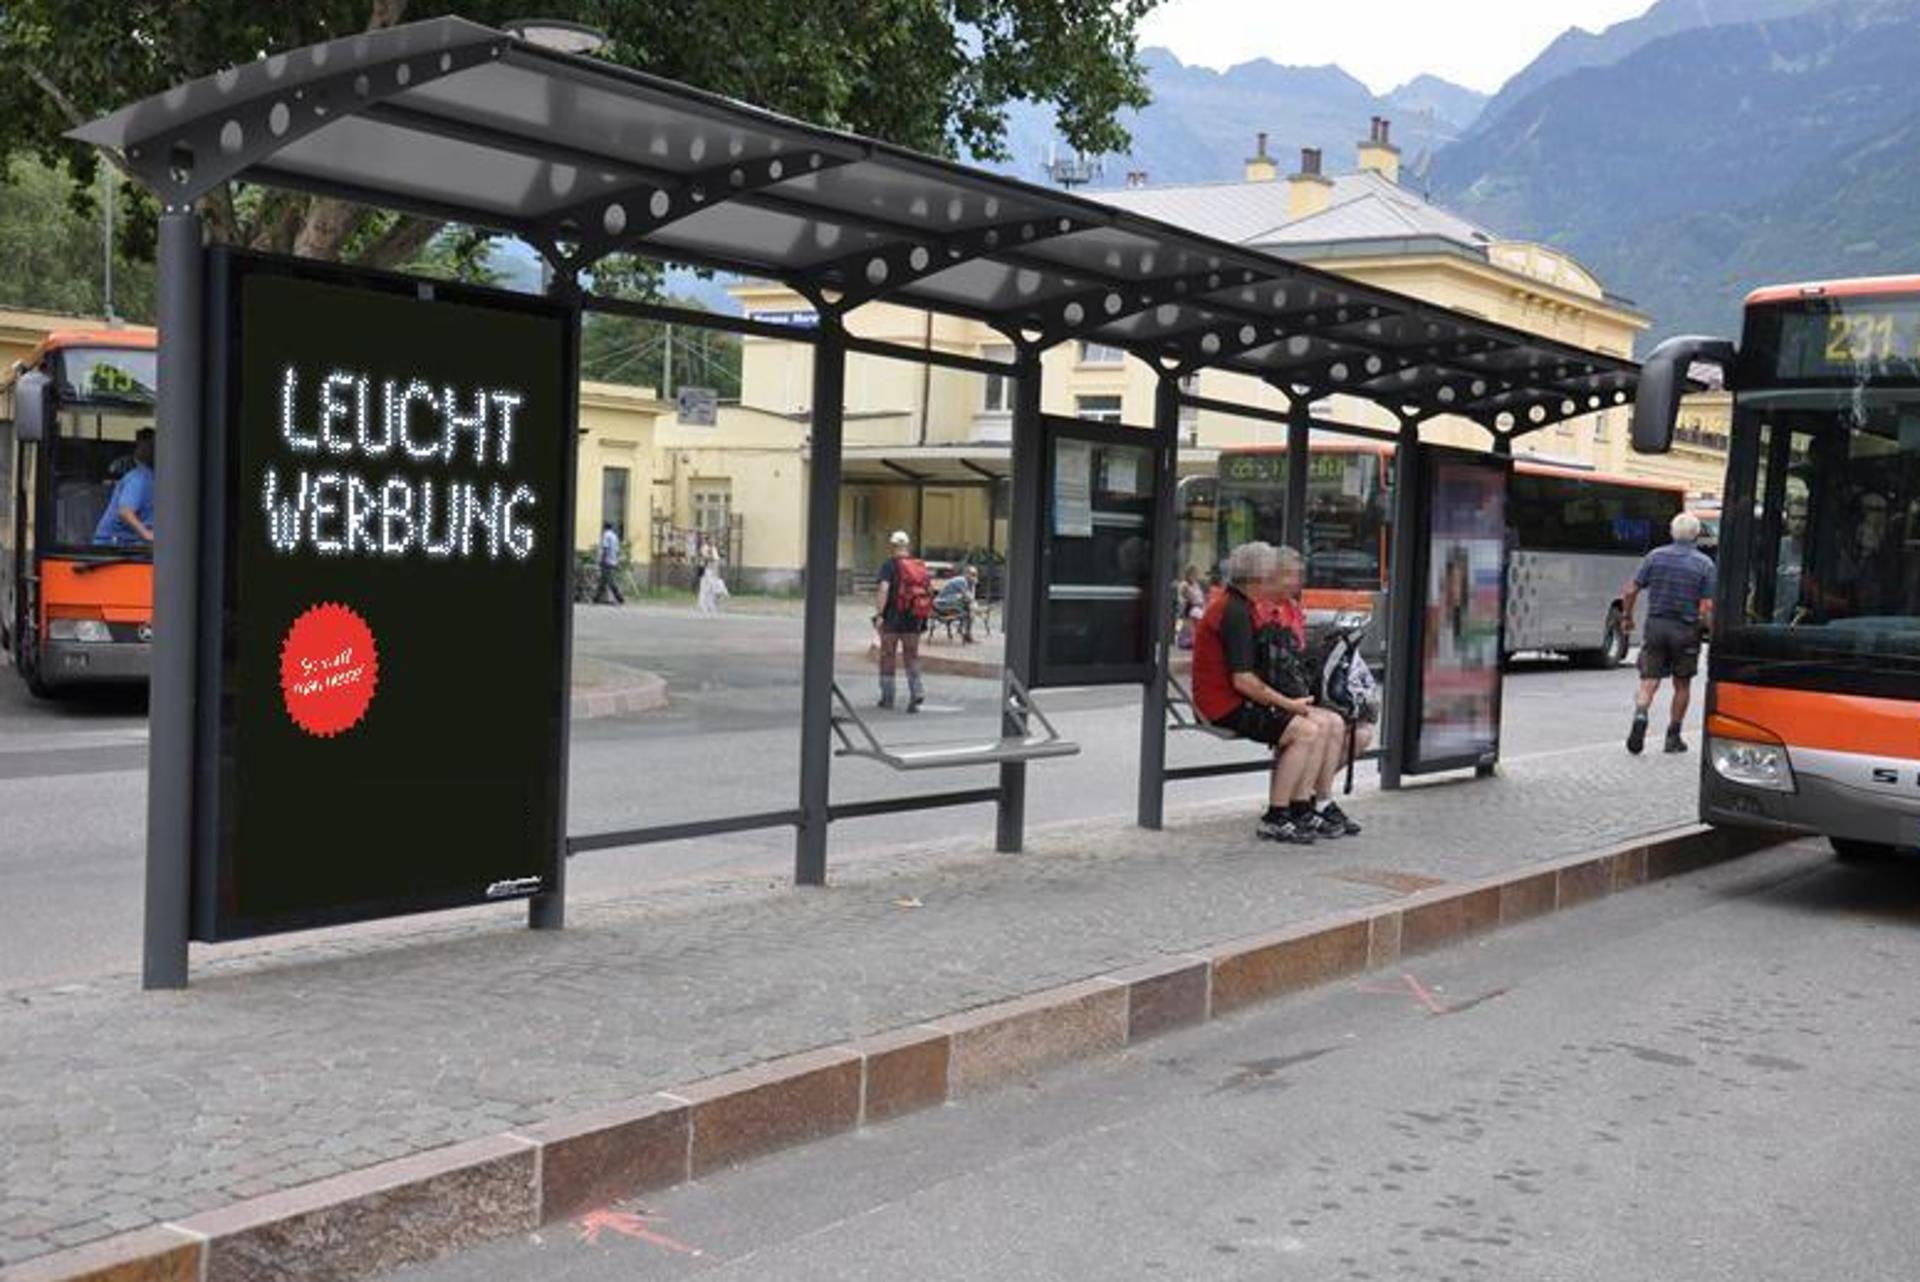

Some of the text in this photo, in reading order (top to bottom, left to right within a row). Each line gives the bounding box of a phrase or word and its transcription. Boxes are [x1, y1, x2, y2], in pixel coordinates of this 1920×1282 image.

[1825, 312, 1893, 361] 231
[282, 366, 522, 464] LEUCHT
[263, 470, 536, 558] WERBUNG
[1873, 767, 1920, 787] S
